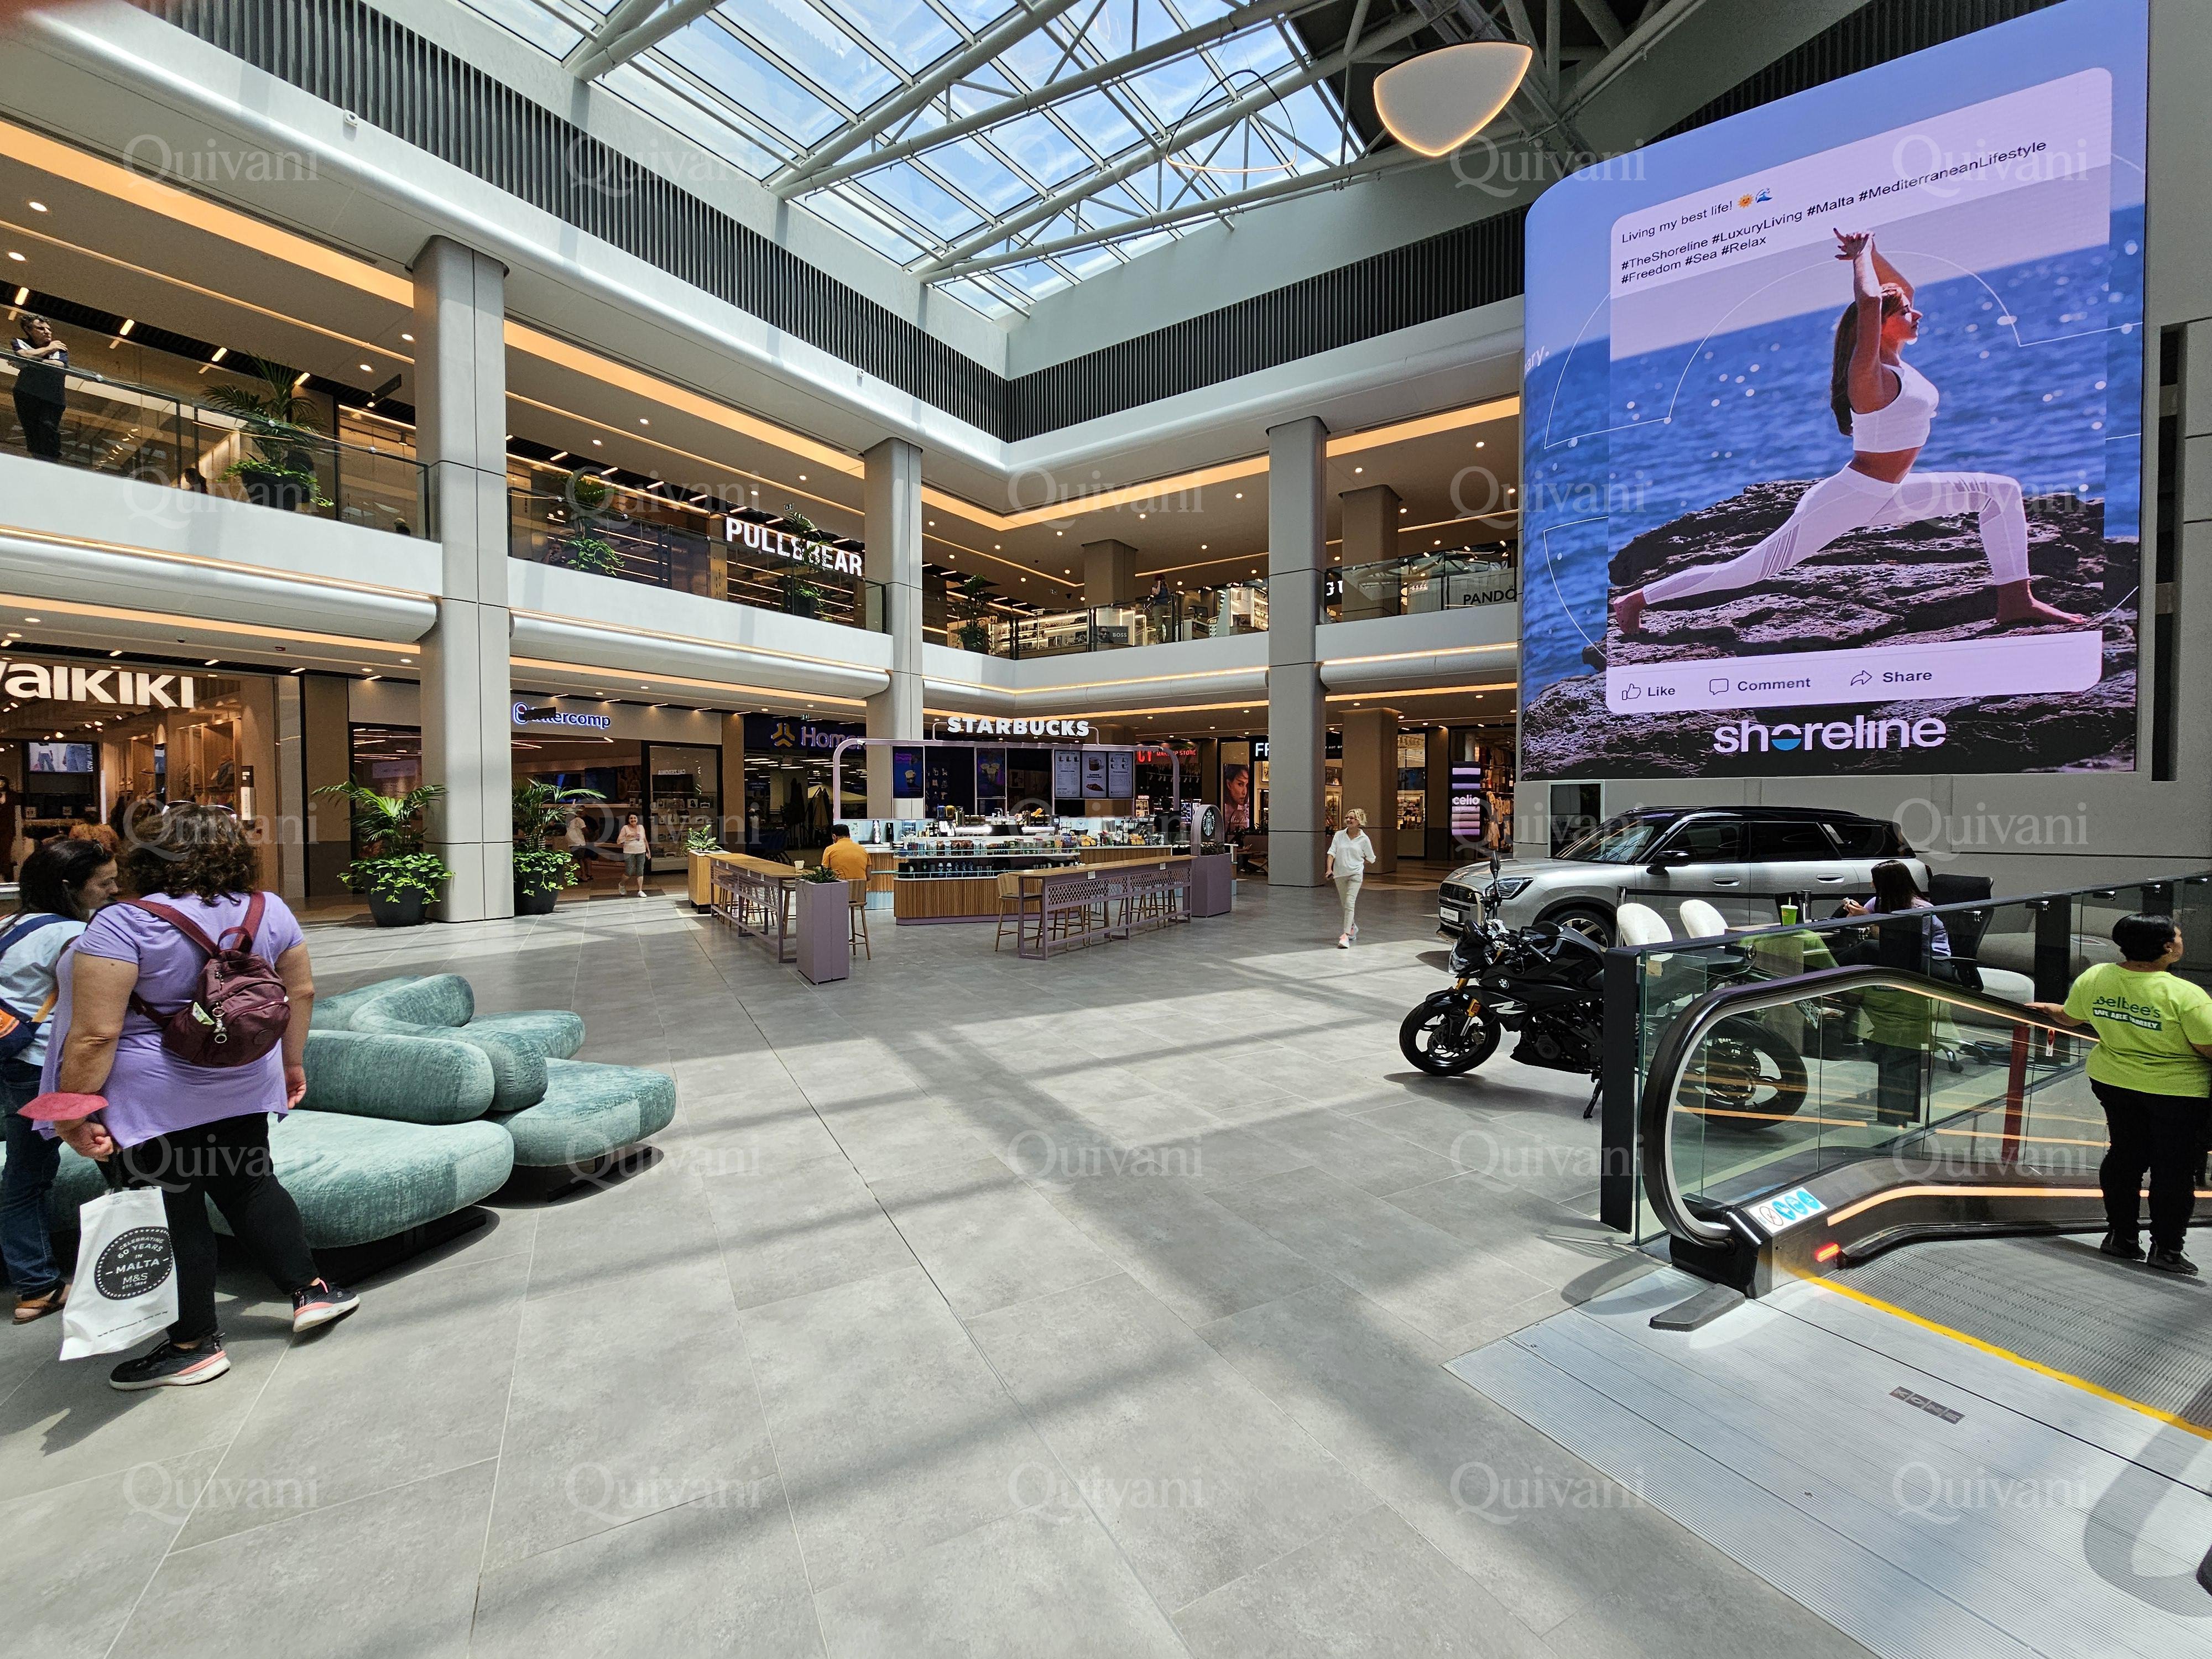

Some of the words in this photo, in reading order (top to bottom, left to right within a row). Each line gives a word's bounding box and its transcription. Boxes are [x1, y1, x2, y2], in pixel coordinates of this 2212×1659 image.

[1621, 238, 1708, 270] #TheShoreline
[1712, 210, 1803, 244] #LuxuryLiving
[1807, 195, 1854, 216] #Malta
[1858, 140, 2047, 201] #MediterraneanLifestyle
[1622, 226, 1655, 243] Living
[1660, 220, 1677, 232] my
[1681, 209, 1708, 225] best
[1711, 201, 1733, 216] life!
[1621, 261, 1681, 284] #Freedom
[1685, 251, 1717, 266] #Sea
[1721, 236, 1767, 255] #Relax
[1738, 677, 1811, 691] Comment
[1882, 671, 1932, 683] Share
[1648, 686, 1676, 697] Like
[947, 716, 1089, 737] STARBUCKS
[1713, 715, 1947, 753] shoreline
[1453, 794, 1479, 805] celio
[117, 1249, 129, 1259] 60
[132, 1243, 163, 1252] YEARS
[119, 1237, 164, 1250] CELEBRATING
[116, 1258, 160, 1274] MALTA
[123, 1272, 148, 1285] M&S
